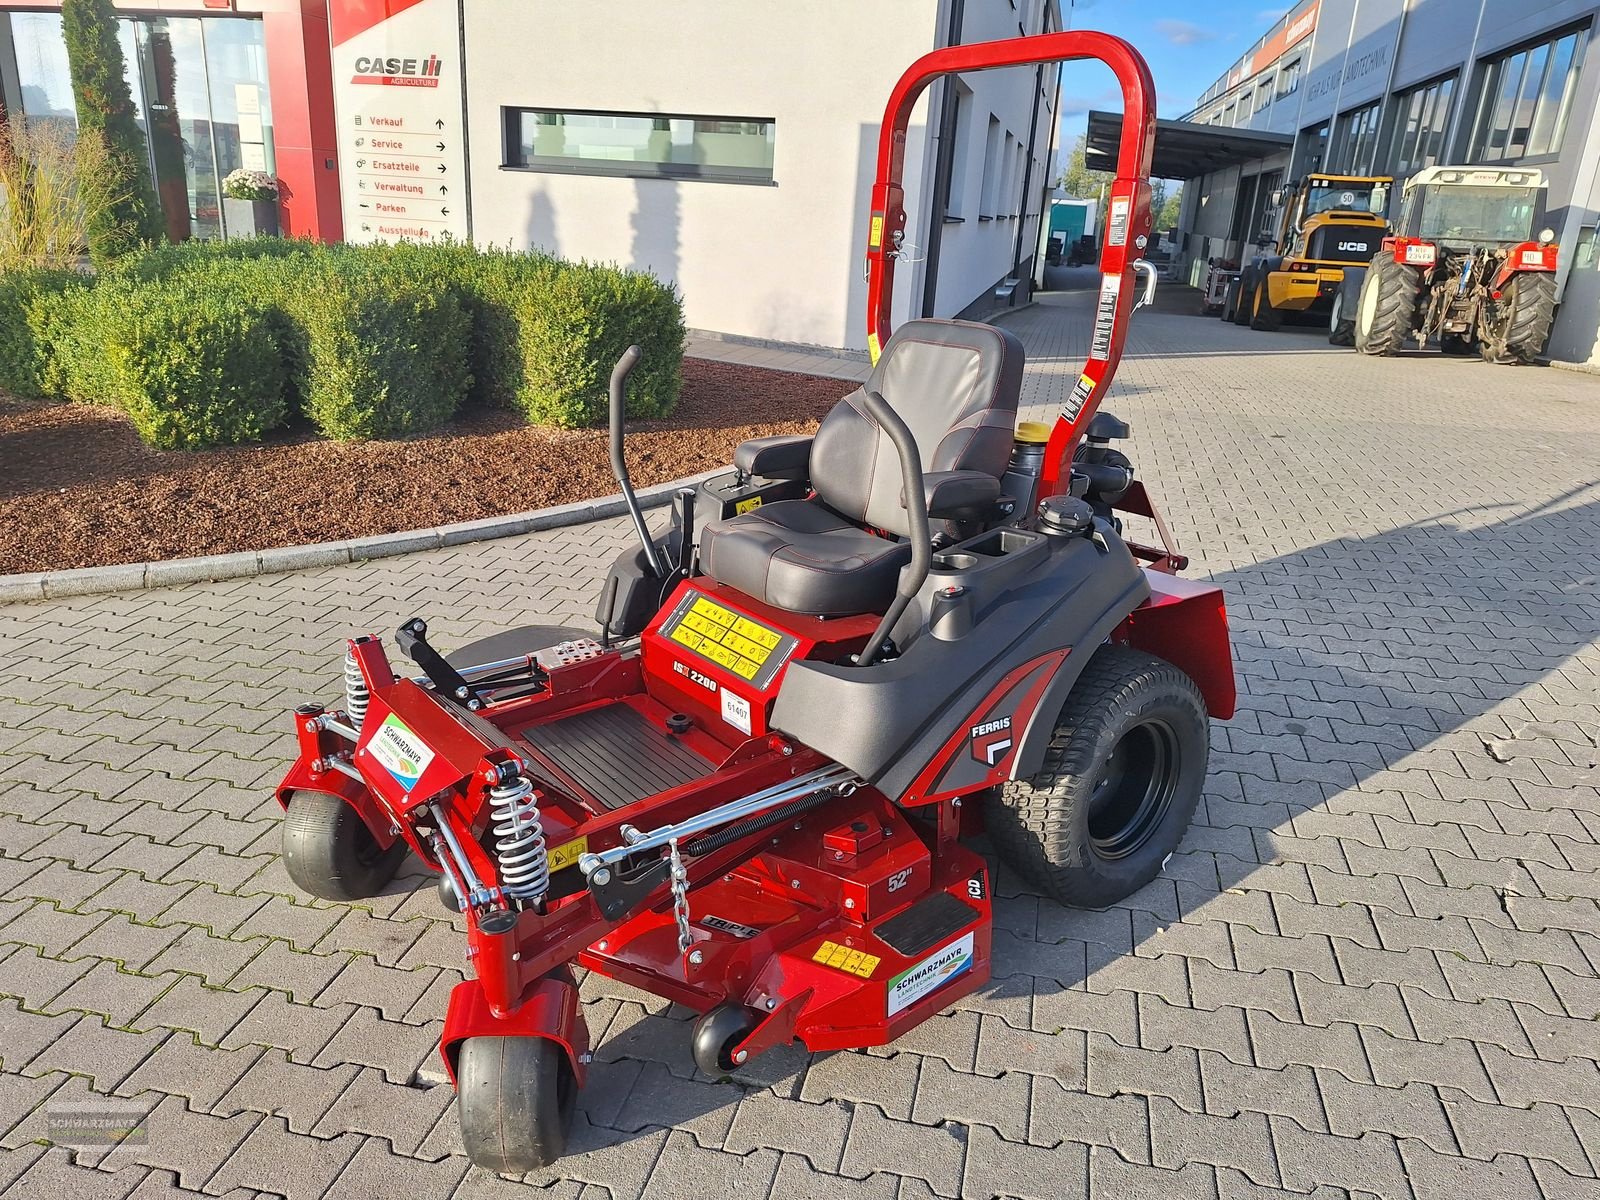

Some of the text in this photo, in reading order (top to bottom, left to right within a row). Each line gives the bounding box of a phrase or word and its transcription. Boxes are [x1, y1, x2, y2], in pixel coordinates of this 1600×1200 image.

[354, 57, 417, 75] CASE
[390, 77, 436, 87] AGRICULTURE
[369, 116, 403, 127] Verkauf
[371, 139, 403, 149] Service
[372, 160, 420, 172] Ersatzteile
[374, 182, 423, 194] Verwaltung
[376, 203, 406, 213] Parken
[378, 225, 429, 238] Ausstellung
[1338, 241, 1368, 252] JCB
[690, 670, 717, 692] 2200
[727, 701, 748, 720] 61407
[971, 717, 1011, 737] FERRIS
[383, 726, 422, 764] SCHWARZMAYR
[703, 916, 759, 937] TRIPLE
[896, 947, 962, 992] SCHWARZMAYR
[897, 972, 937, 999] LANDTECHNIK
